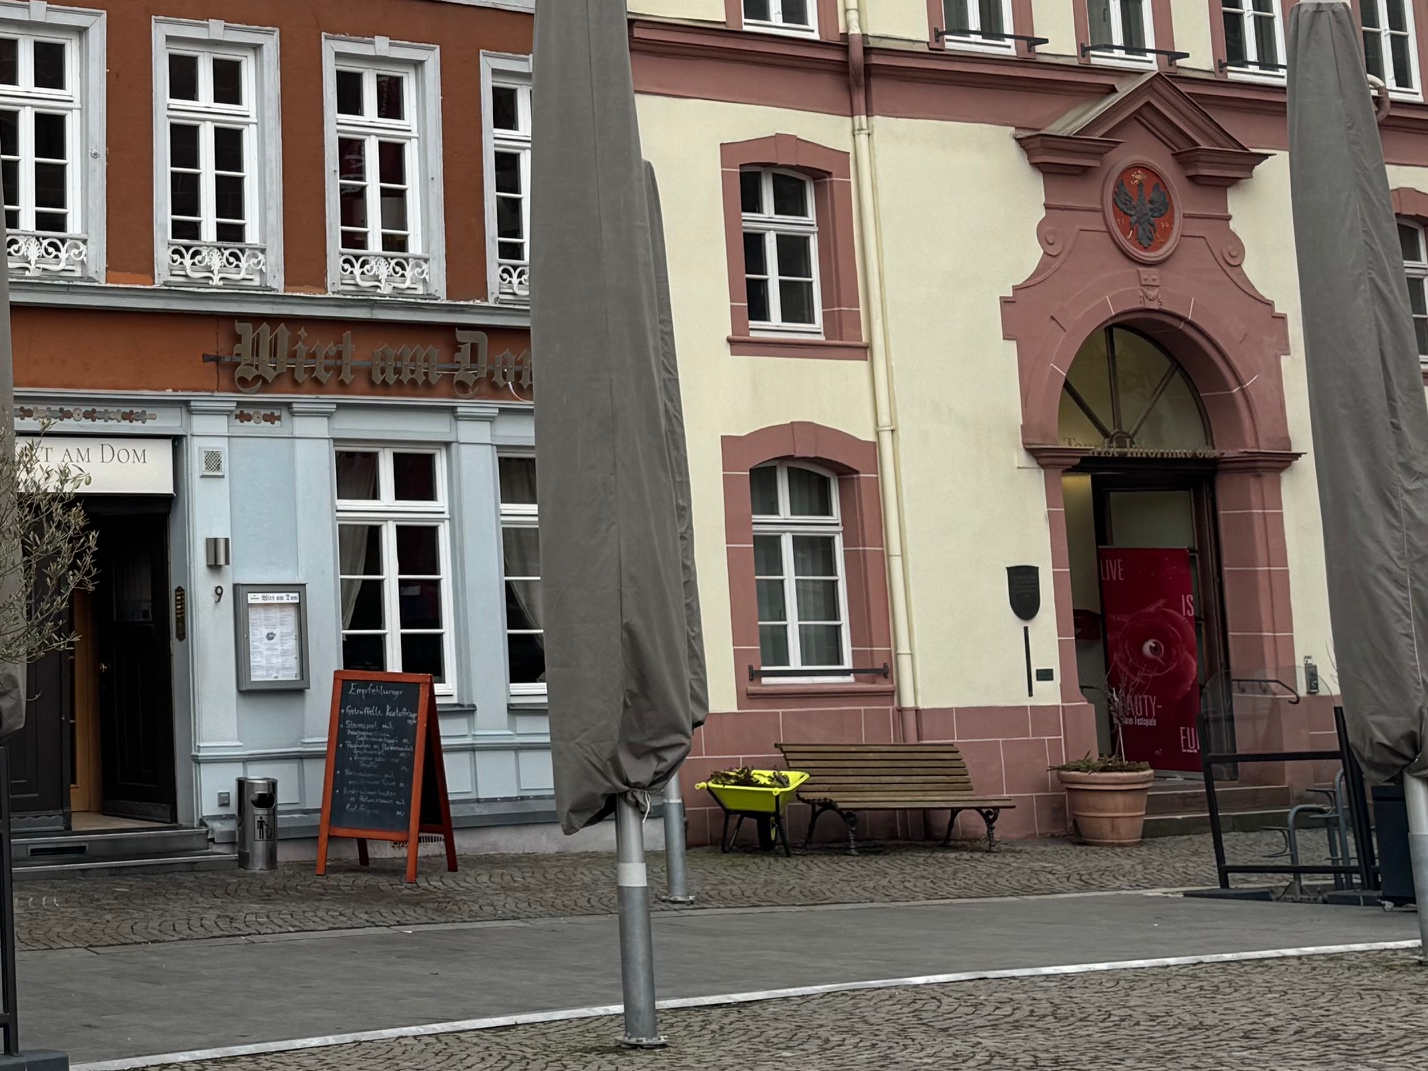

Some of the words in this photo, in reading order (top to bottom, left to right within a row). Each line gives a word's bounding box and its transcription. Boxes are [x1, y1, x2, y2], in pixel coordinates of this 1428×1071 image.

[233, 319, 356, 394] Wirt
[372, 343, 443, 386] am
[1100, 558, 1124, 580] LIVE
[214, 585, 224, 603] 9
[1181, 594, 1195, 617] IS
